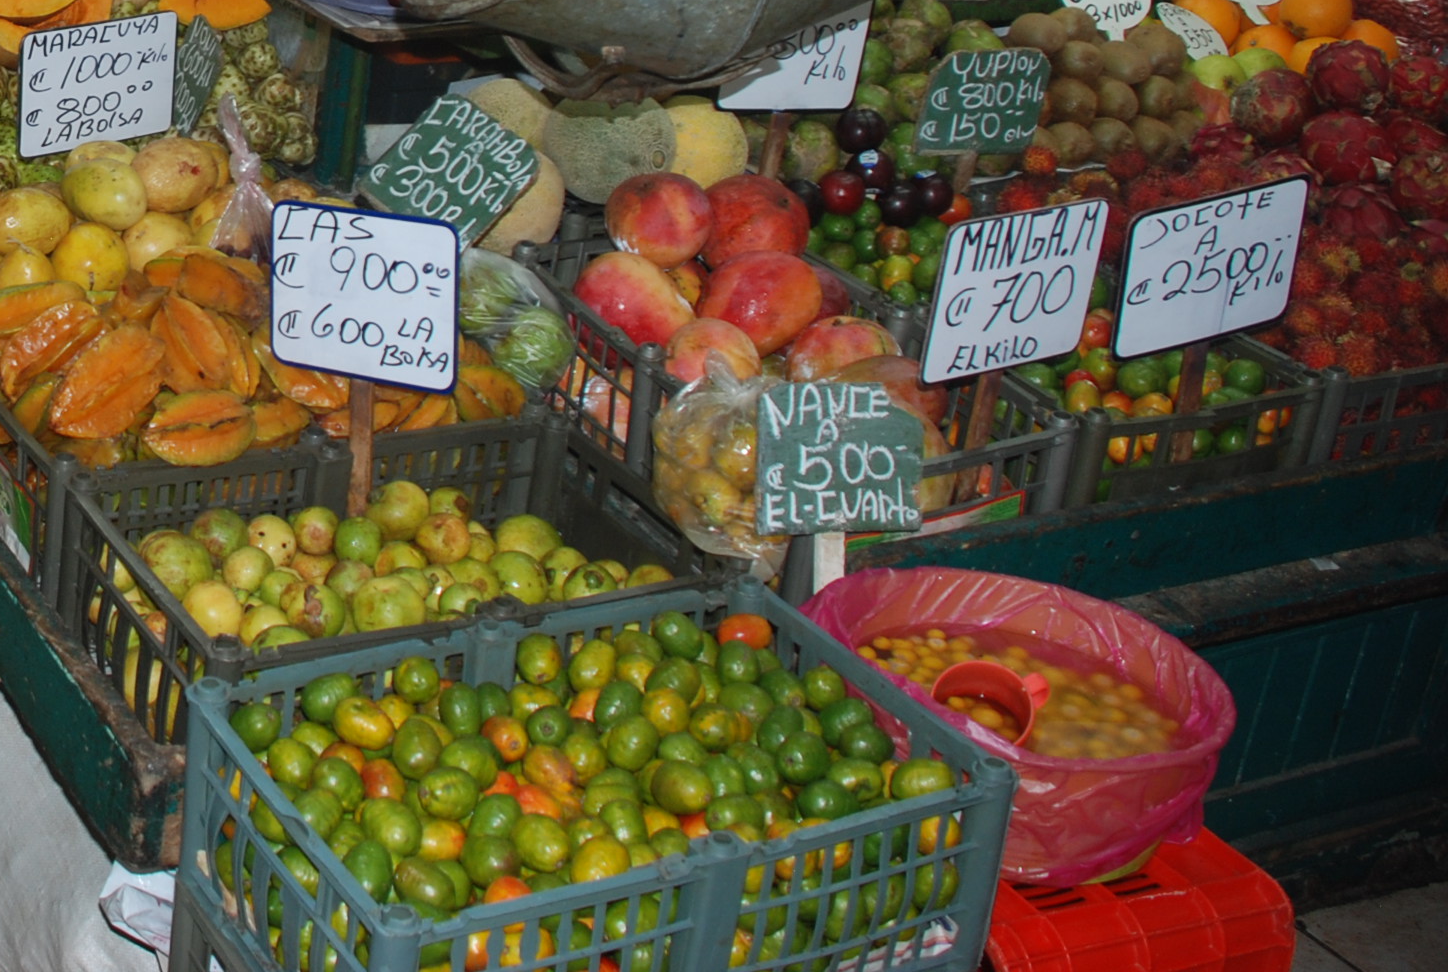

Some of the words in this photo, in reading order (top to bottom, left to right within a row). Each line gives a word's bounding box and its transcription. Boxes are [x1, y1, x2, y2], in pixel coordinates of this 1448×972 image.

[28, 15, 159, 61] MARACUYA
[278, 206, 374, 244] CAS
[1140, 191, 1274, 249] JOCOTE
[1194, 225, 1218, 255] A
[982, 265, 1075, 332] 700
[311, 303, 384, 347] 600
[398, 317, 434, 343] LA
[763, 383, 890, 440] NANCE
[815, 419, 839, 443] A
